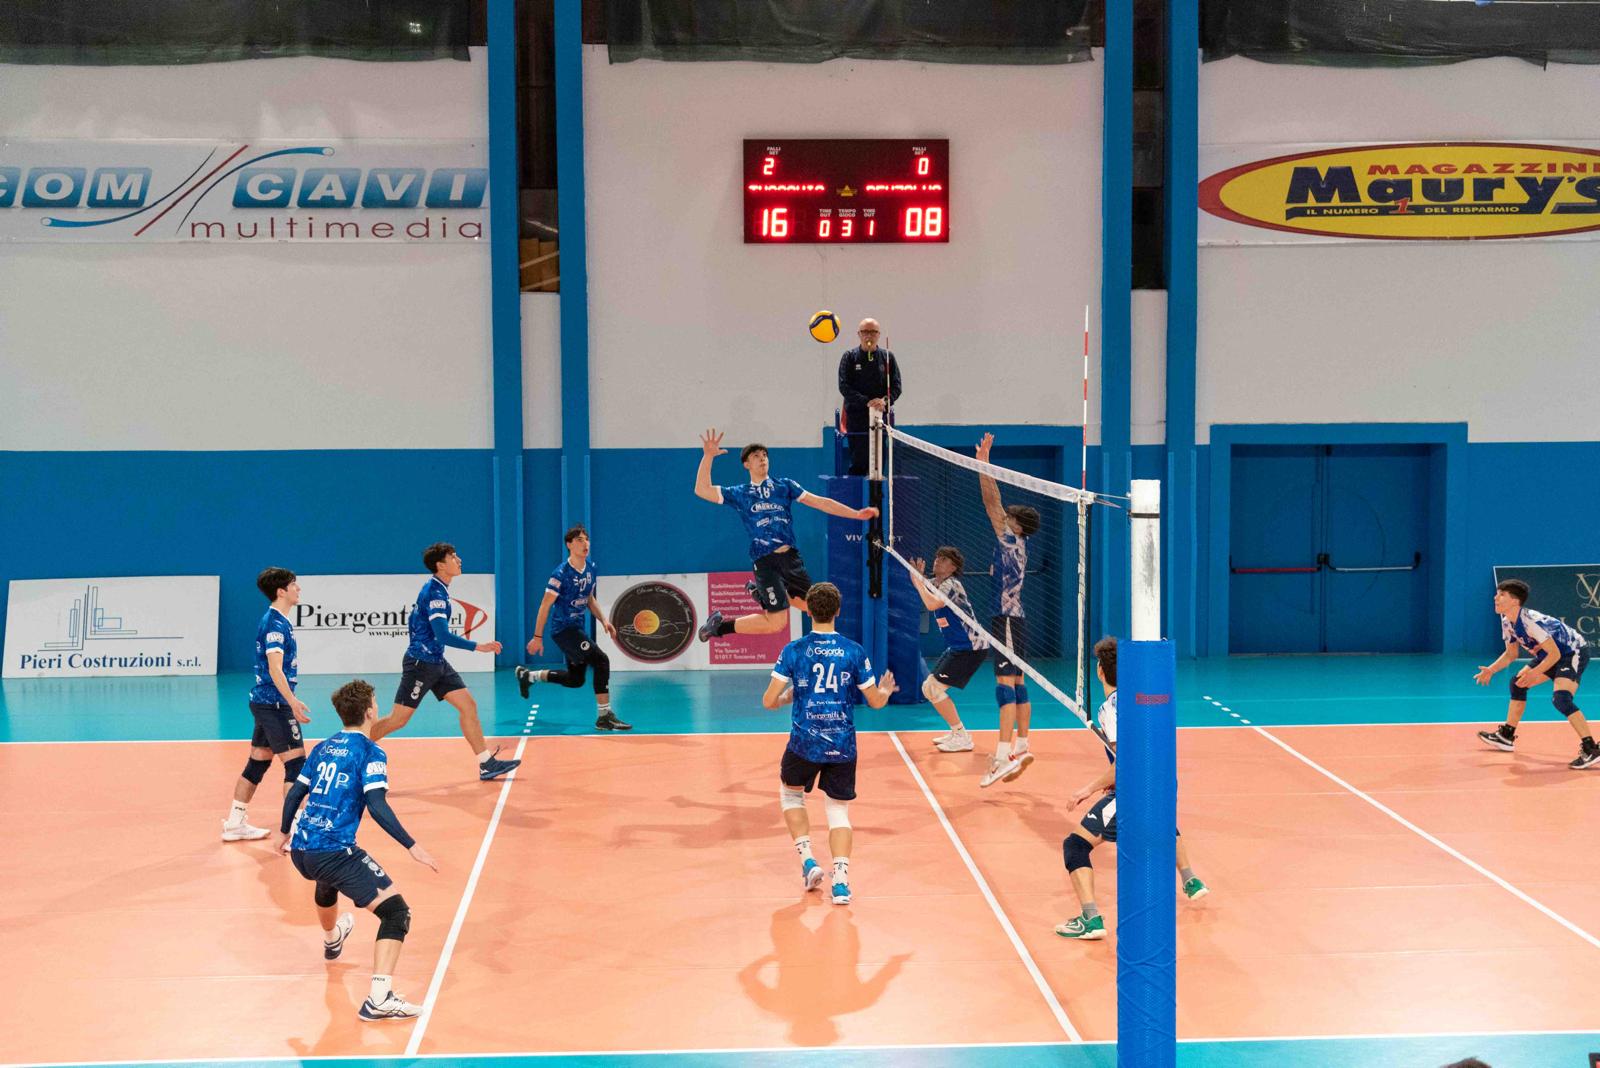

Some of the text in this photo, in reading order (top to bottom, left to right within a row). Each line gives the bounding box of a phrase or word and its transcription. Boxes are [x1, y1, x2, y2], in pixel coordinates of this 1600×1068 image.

[763, 157, 775, 176] 2
[918, 157, 930, 176] 0
[0, 172, 468, 201] OM CAVI
[1322, 207, 1379, 215] NUMERO
[1390, 197, 1414, 214] 1
[1424, 206, 1448, 214] DEL
[1452, 206, 1520, 214] RISPARMIO
[190, 216, 483, 238] multimedia
[761, 207, 788, 237] 16
[819, 219, 875, 237] 0 3 1
[904, 206, 942, 237] 08
[20, 652, 202, 669] Pieri Costruzioni s.r.l.
[812, 662, 839, 694] 24
[311, 761, 337, 795] 29
